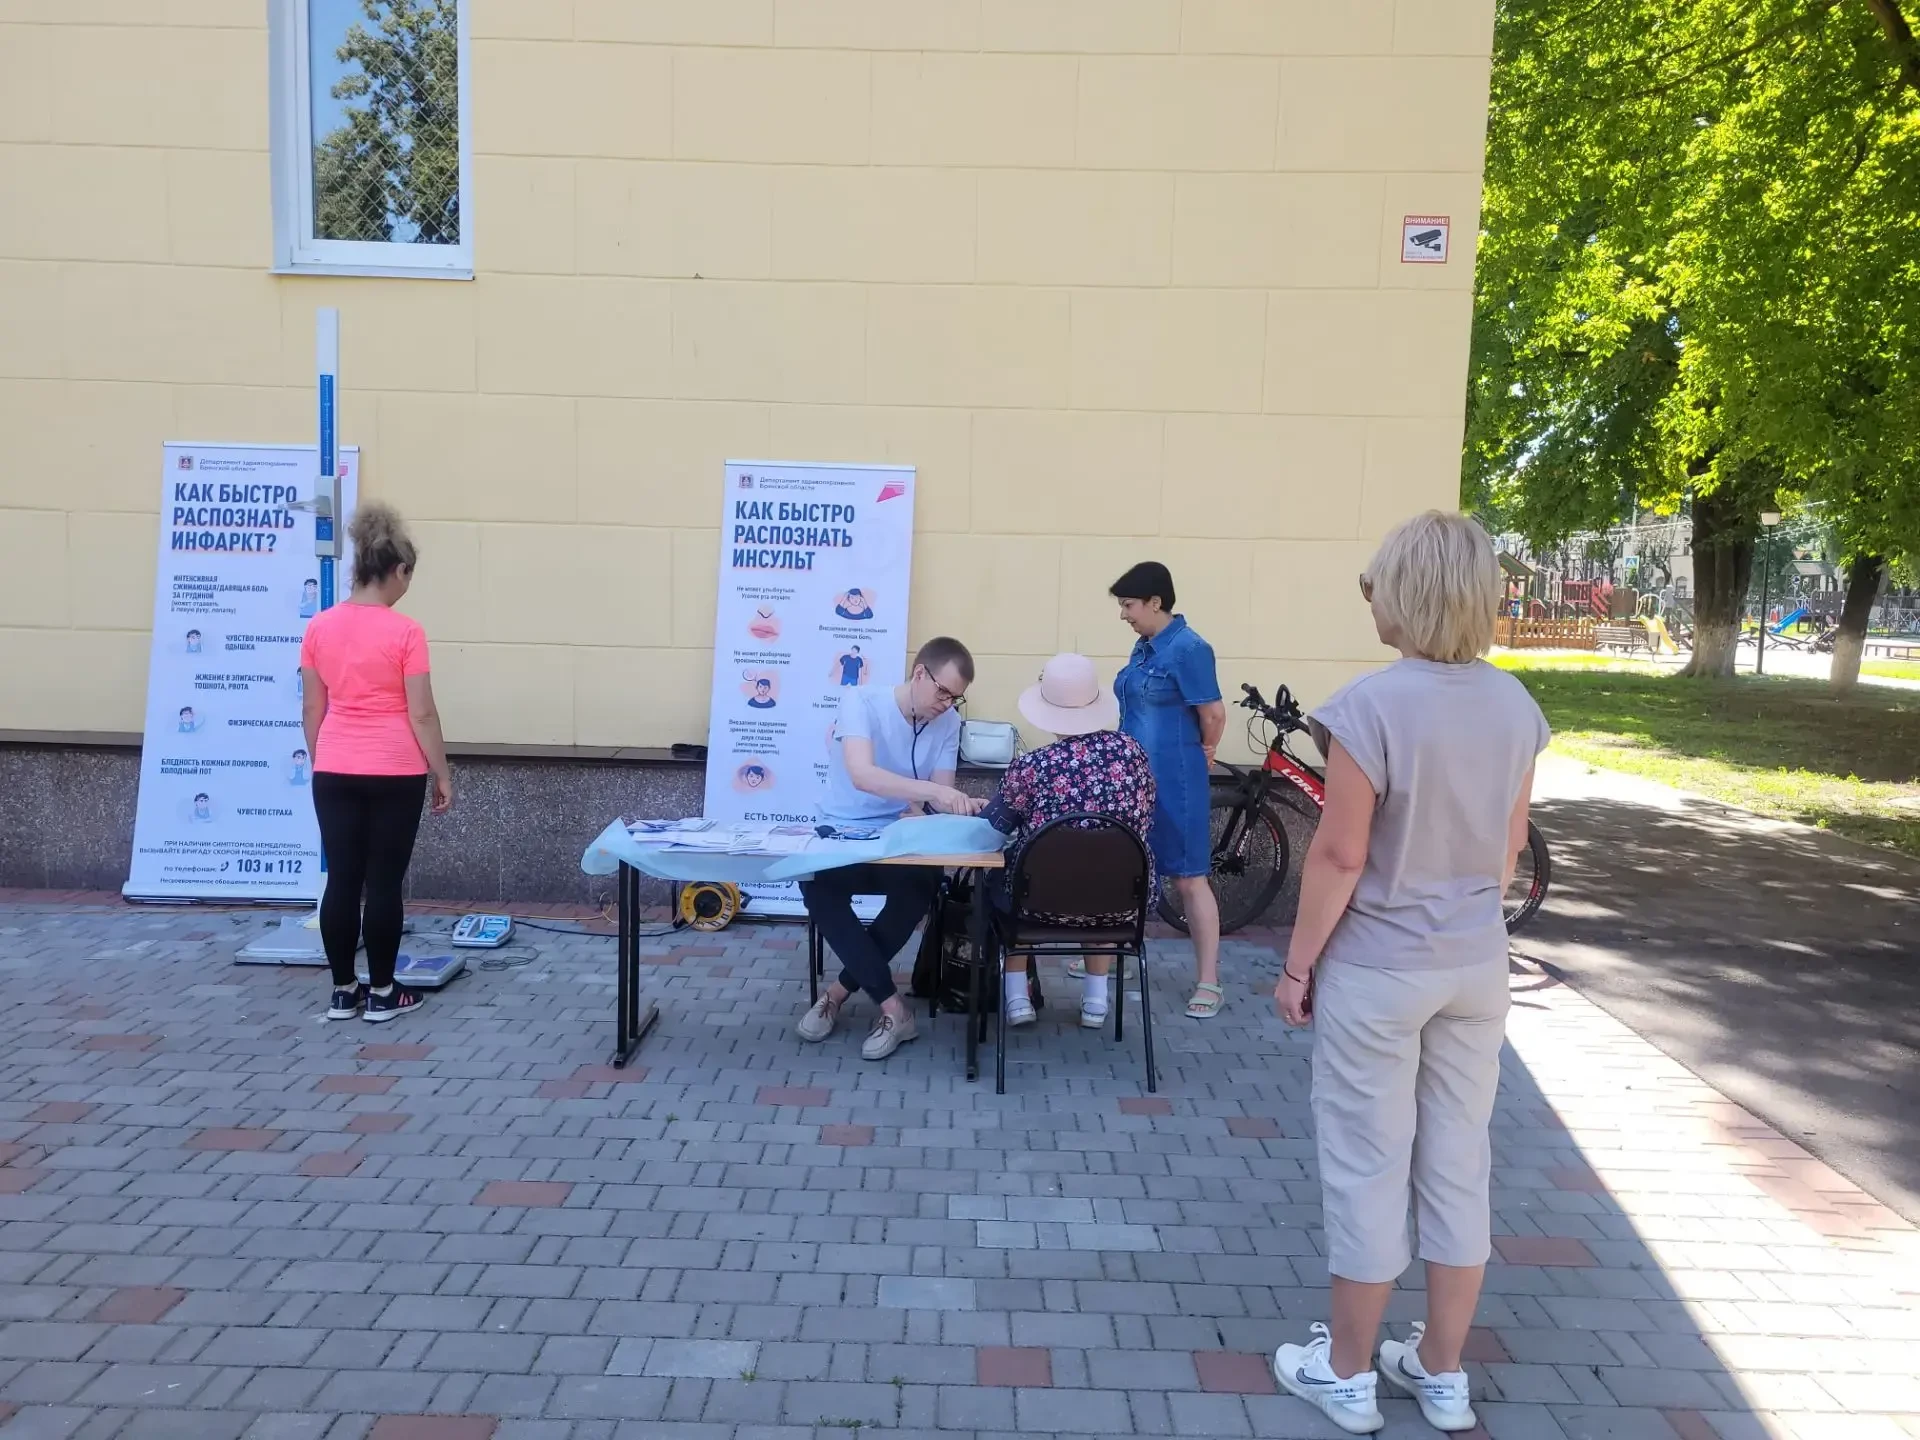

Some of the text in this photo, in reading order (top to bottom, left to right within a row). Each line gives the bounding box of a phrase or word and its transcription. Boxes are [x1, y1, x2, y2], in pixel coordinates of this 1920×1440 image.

[174, 483, 297, 504] КАК БЫСТРО
[735, 500, 855, 523] КАК БЫСТРО
[173, 507, 295, 528] РАСПОЗНАТЬ
[734, 524, 853, 547] РАСПОЗНАТЬ
[171, 531, 277, 552] ИНФАРКТ?
[733, 548, 816, 570] ИНСУЛЬТ
[226, 634, 254, 642] ЧУВСТВО
[256, 635, 289, 643] НЕХВАТКИ
[225, 643, 255, 651] ОДЫШКА
[228, 719, 273, 727] ФИЗИЧЕСКАЯ
[161, 758, 270, 768] БЛЕДНОСТЬ КОЖНЫХ ПОКРОВОВ,
[160, 767, 198, 775] ХОЛОДНЫЙ
[268, 808, 293, 816] СТРАХА
[744, 812, 817, 823] ЕСТЬ ТОЛЬКО 4
[237, 859, 261, 873] 103
[265, 862, 273, 873] и
[278, 859, 302, 873] 112
[741, 881, 782, 889] телефонам:
